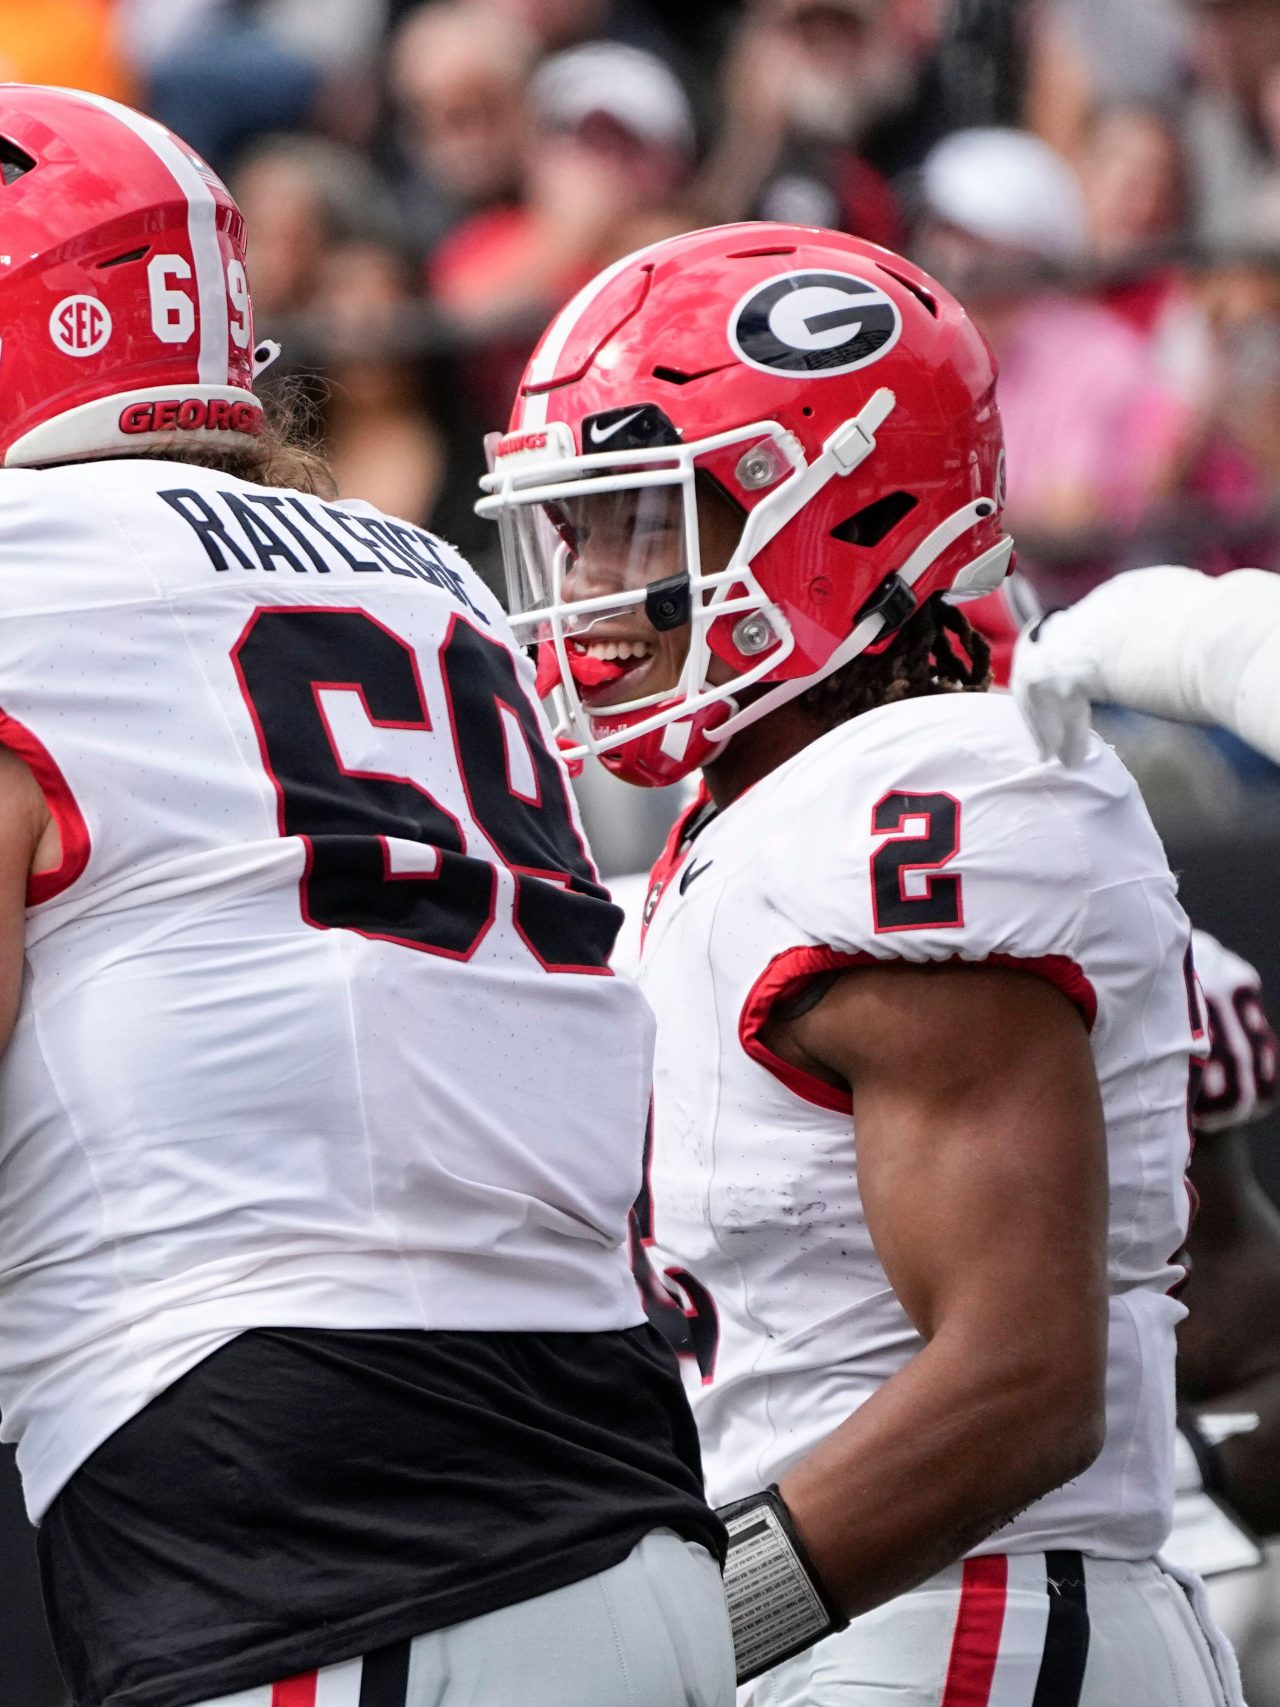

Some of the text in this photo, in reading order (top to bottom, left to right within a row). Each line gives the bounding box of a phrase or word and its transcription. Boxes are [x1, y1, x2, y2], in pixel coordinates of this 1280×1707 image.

[57, 300, 105, 350] SEC
[155, 488, 491, 626] RATLEDGE
[229, 605, 625, 977] 69
[869, 789, 965, 934] 2
